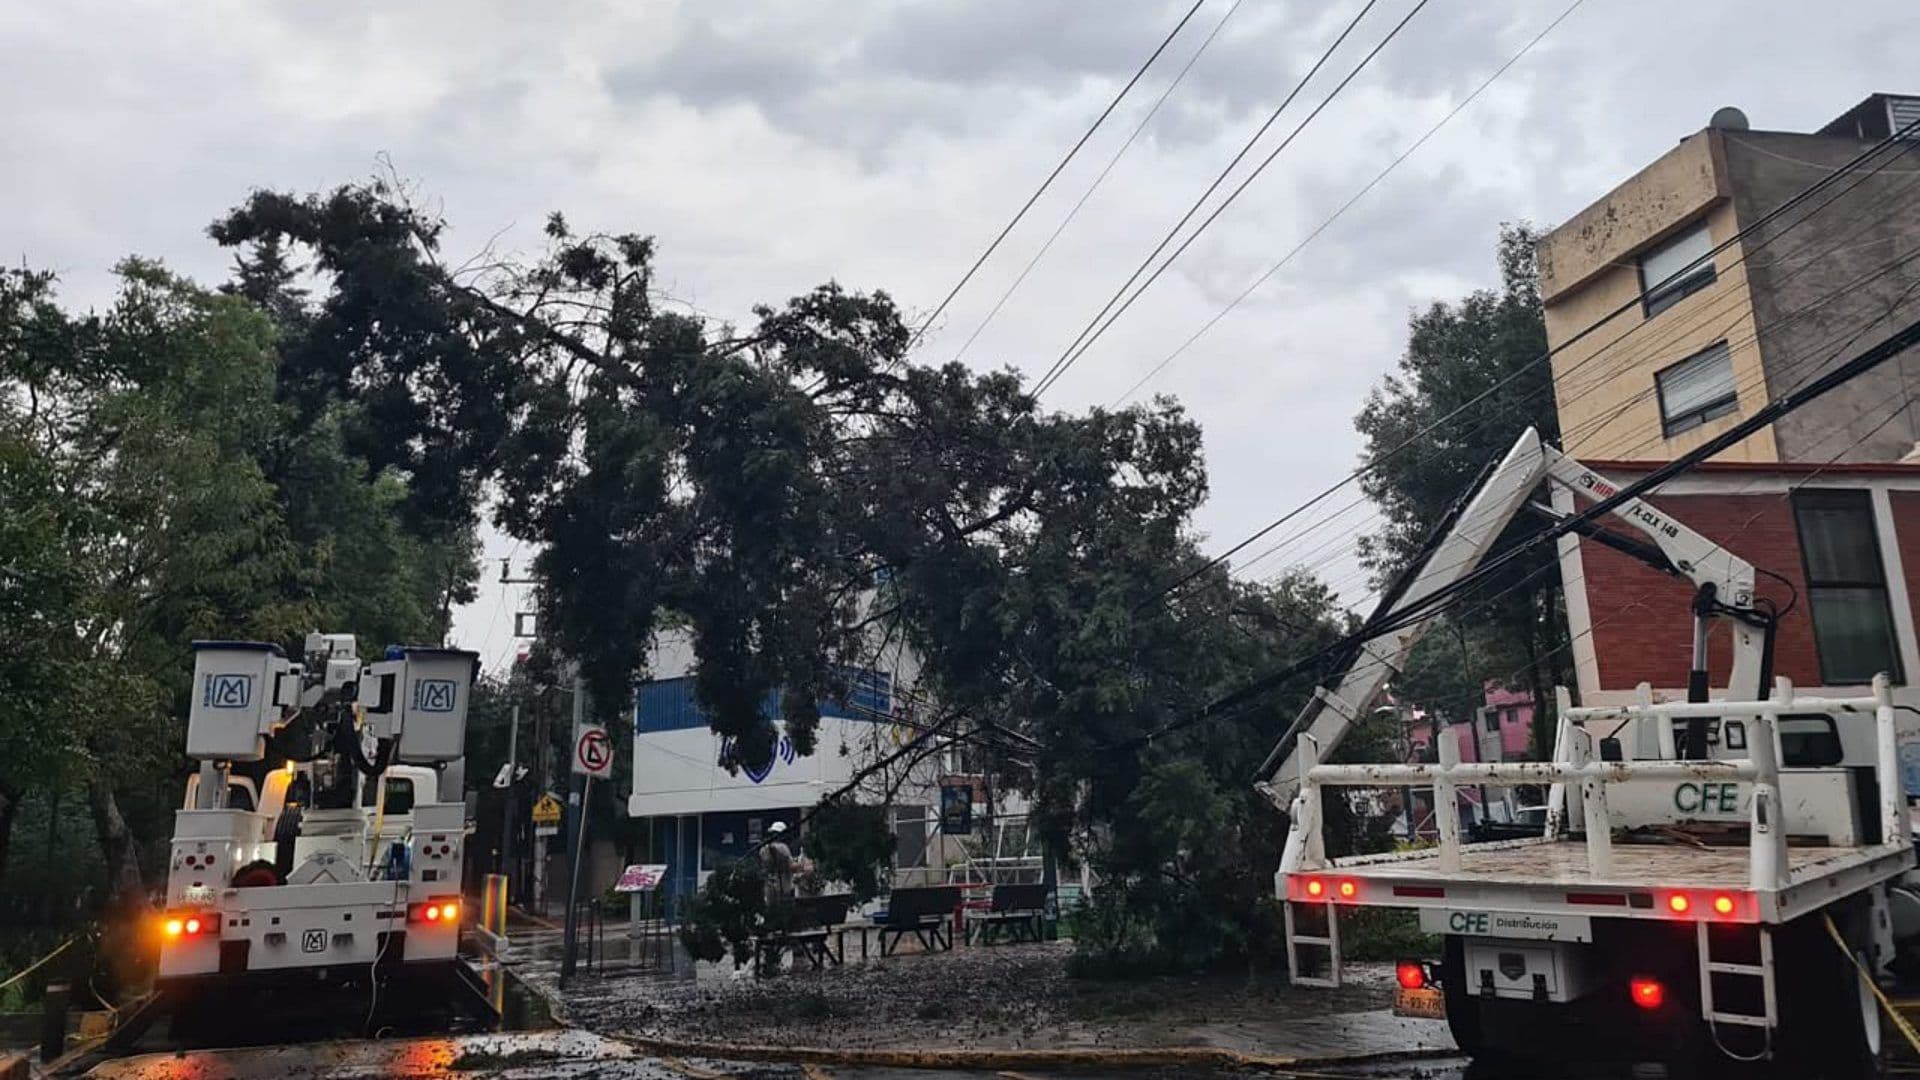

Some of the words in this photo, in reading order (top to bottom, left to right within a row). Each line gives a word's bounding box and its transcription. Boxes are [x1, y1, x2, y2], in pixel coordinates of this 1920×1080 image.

[1675, 782, 1738, 812] CFE
[1449, 912, 1488, 933] CFE
[1496, 916, 1558, 931] Distribución
